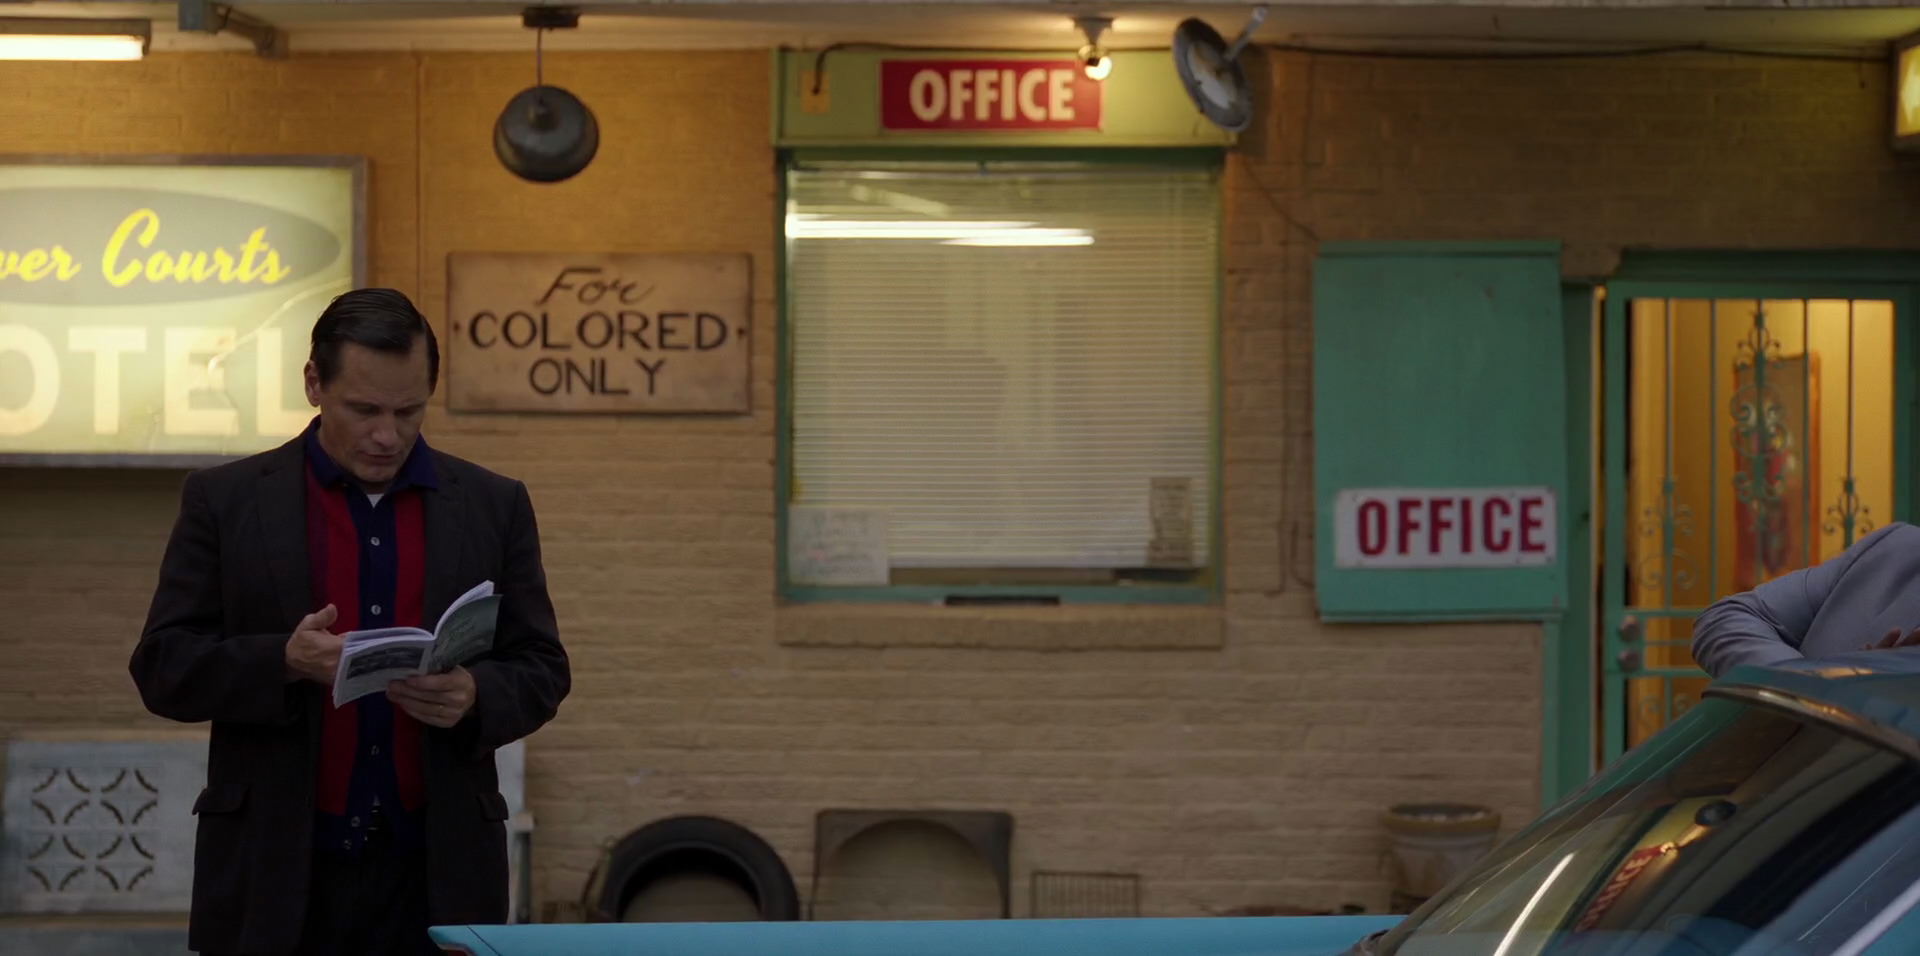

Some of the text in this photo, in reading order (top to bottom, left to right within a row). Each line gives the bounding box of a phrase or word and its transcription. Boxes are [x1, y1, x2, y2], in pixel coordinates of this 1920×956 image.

[909, 68, 1075, 121] OFFICE
[102, 208, 291, 287] Courts
[536, 266, 655, 306] For
[469, 311, 727, 351] COLORED
[529, 357, 666, 396] ONLY
[1357, 496, 1546, 556] OFFICE
